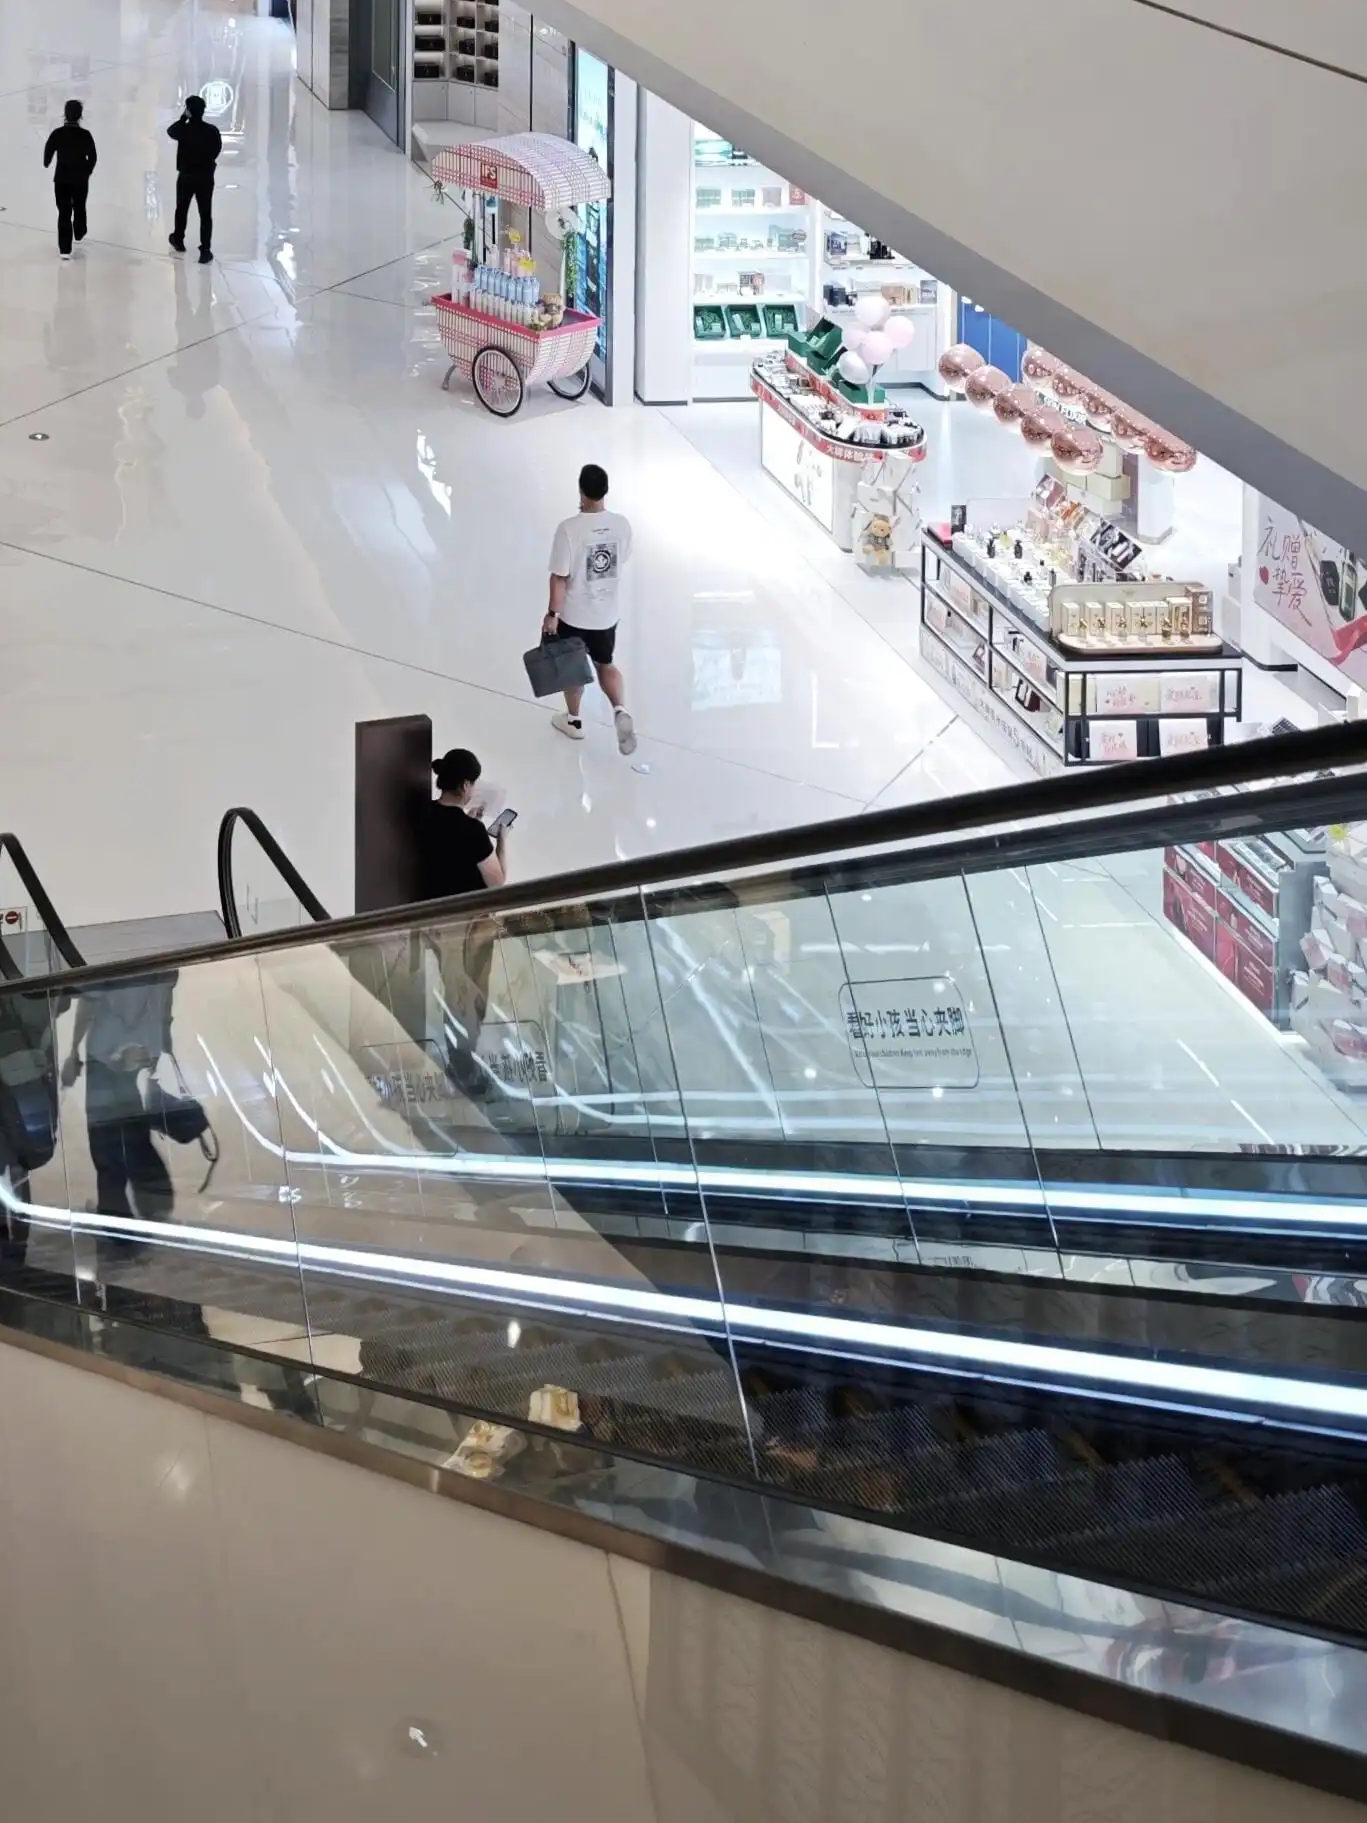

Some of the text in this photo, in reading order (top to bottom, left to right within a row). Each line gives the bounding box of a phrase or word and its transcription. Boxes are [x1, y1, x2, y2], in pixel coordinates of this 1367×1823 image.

[481, 164, 497, 180] IFS
[846, 1007, 965, 1039] 看好小孩当心夹脚
